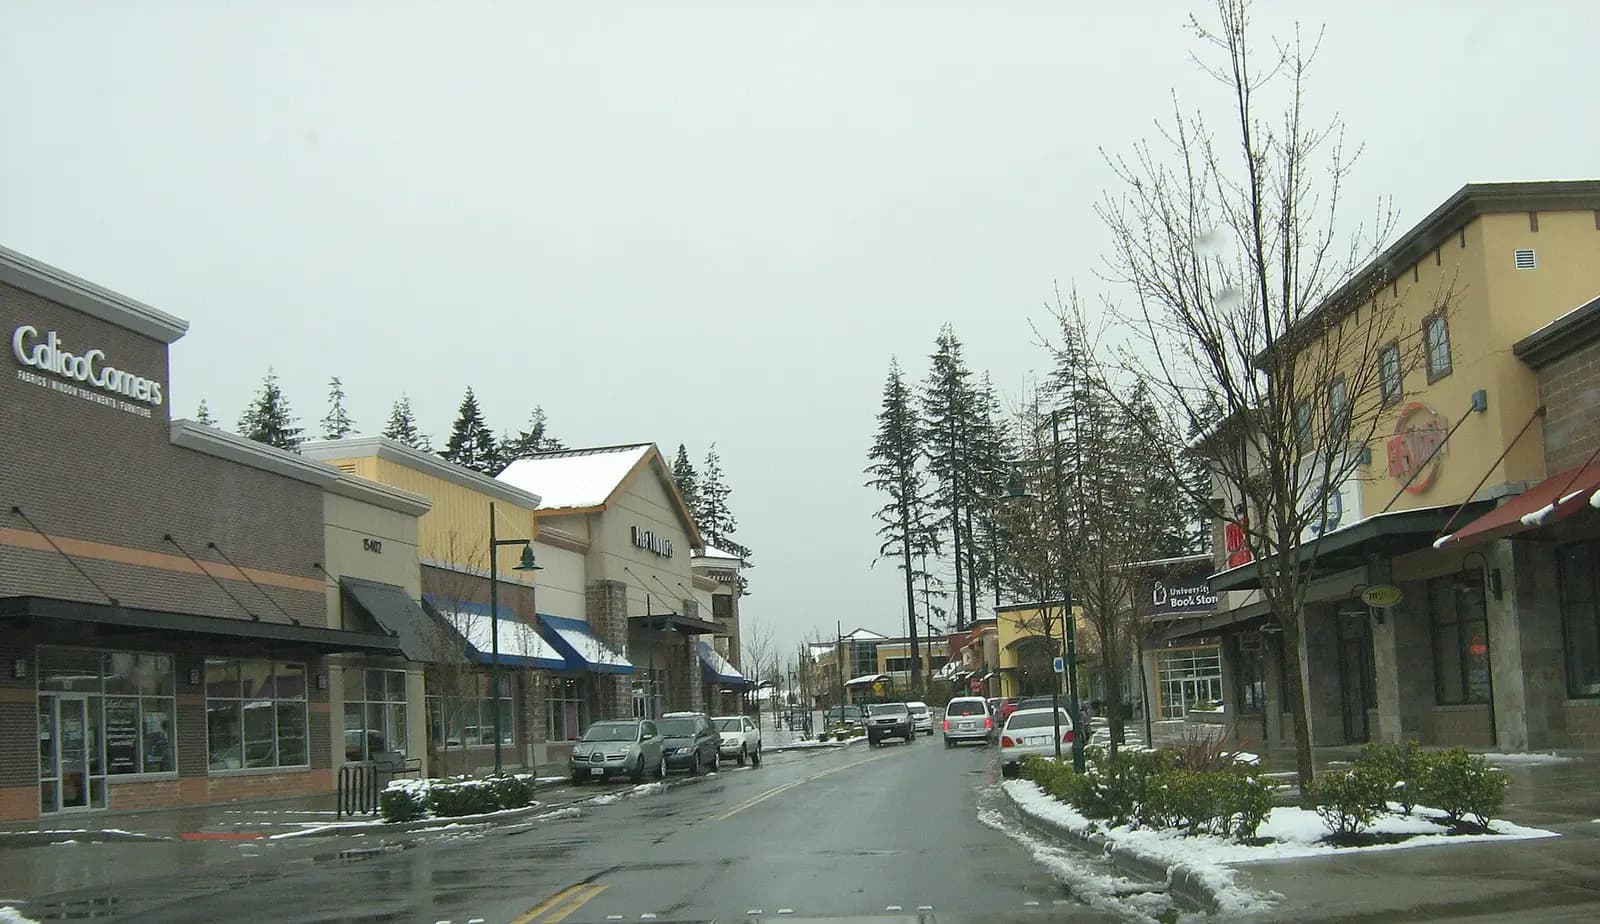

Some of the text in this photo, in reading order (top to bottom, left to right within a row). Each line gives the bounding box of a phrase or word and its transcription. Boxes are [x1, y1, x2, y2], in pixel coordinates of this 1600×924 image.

[17, 370, 46, 387] FABRICS
[52, 380, 78, 396] WINDOW
[79, 388, 116, 409] TREATMENTS
[1170, 584, 1209, 596] University
